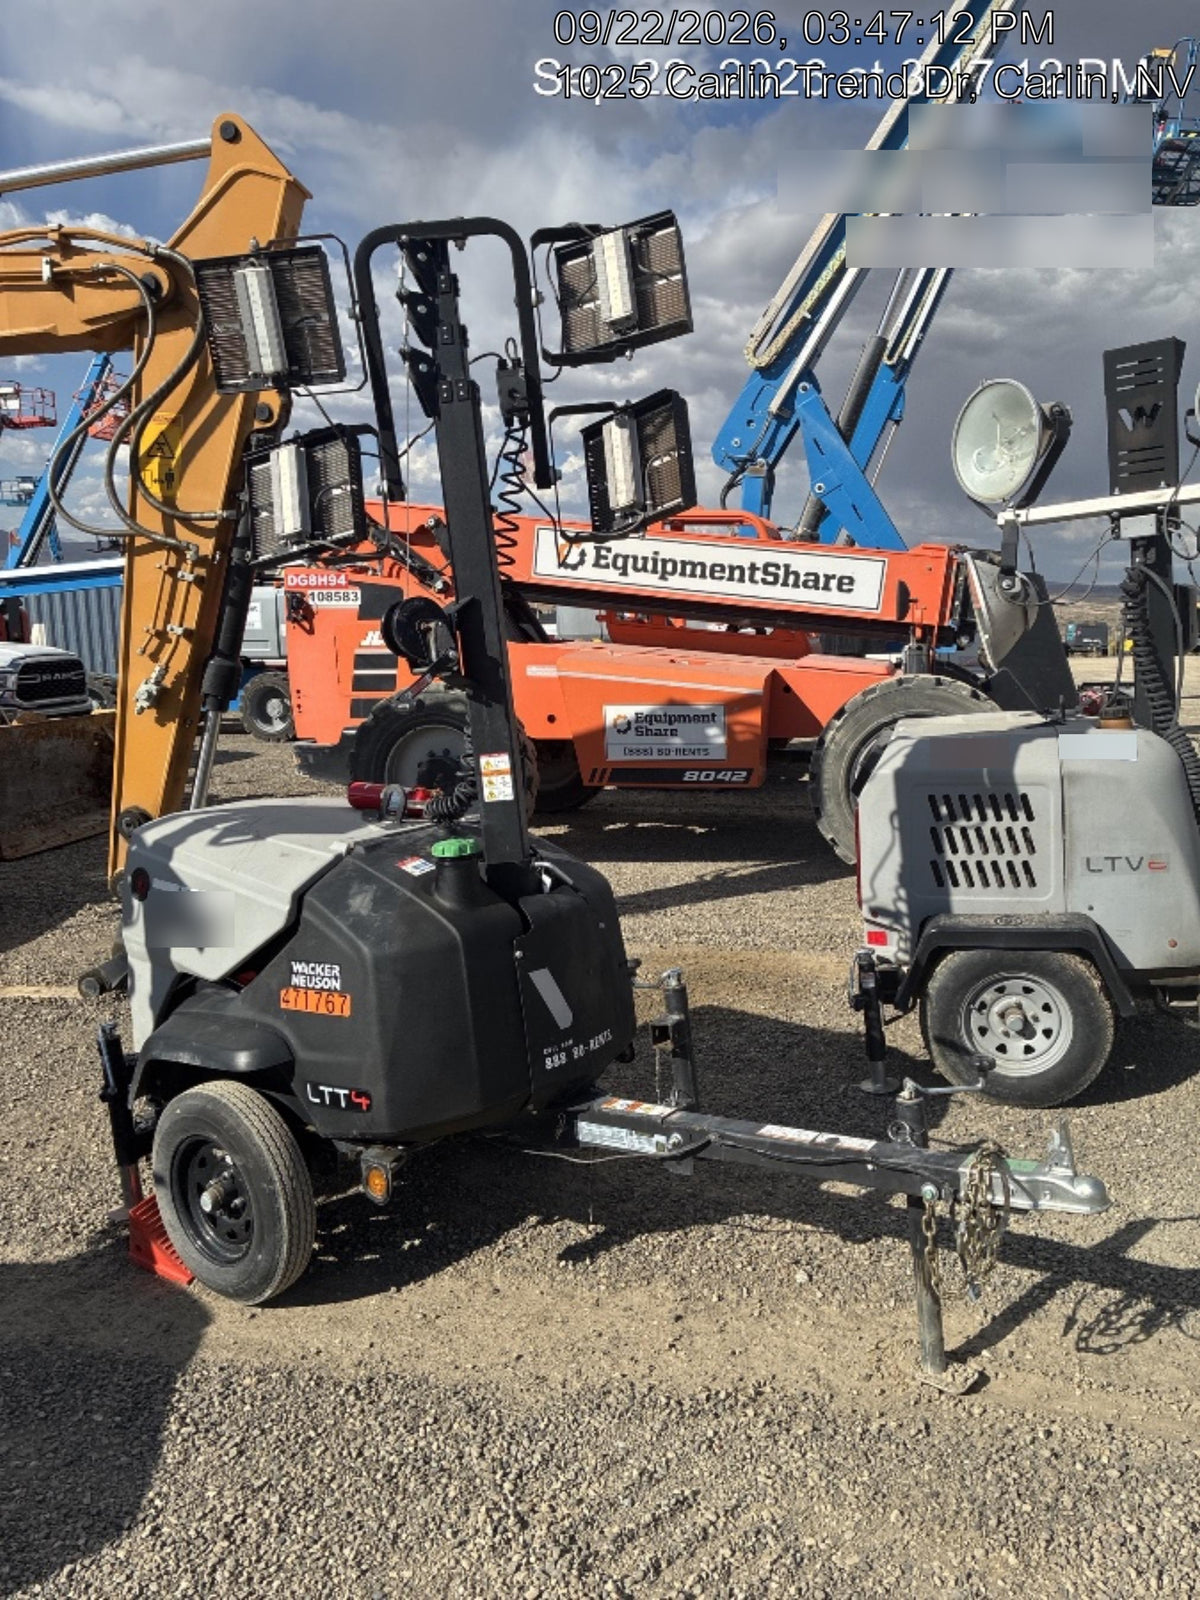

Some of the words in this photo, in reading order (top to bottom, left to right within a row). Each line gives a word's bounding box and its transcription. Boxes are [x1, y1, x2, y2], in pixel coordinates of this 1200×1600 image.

[591, 545, 856, 594] EquipmentShare
[287, 574, 347, 587] DG8H94
[309, 591, 360, 602] 108583
[634, 712, 717, 726] Equipment
[634, 725, 678, 737] Share
[682, 771, 748, 782] 8042
[290, 961, 340, 977] WACKER
[290, 974, 341, 991] NEUSON
[306, 1083, 371, 1111] LTT4
